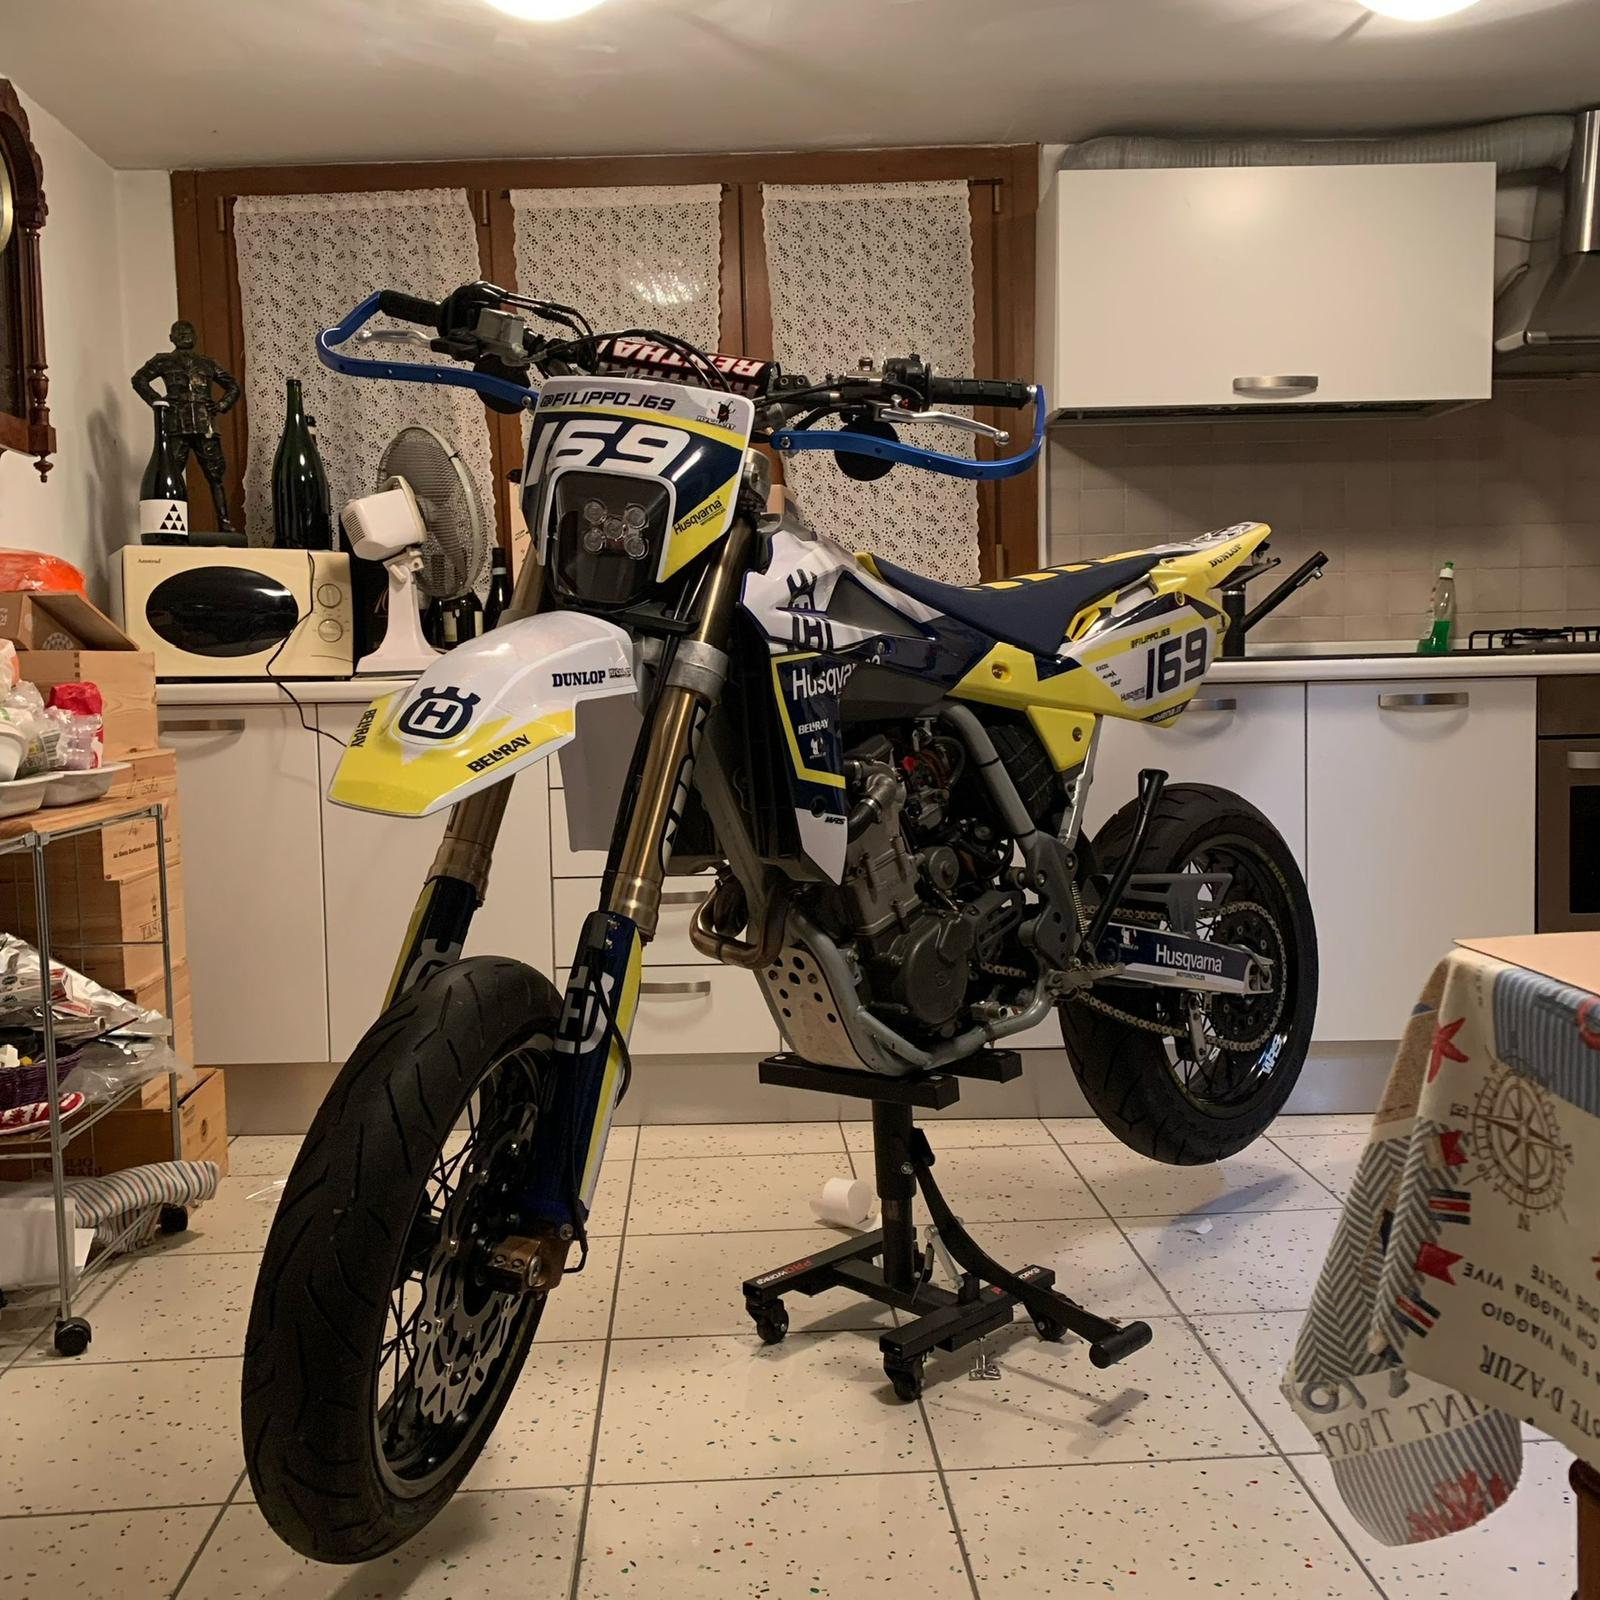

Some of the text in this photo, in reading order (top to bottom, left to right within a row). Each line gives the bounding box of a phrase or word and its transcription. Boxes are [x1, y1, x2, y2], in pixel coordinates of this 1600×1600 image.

[539, 391, 676, 411] @FILIPPO_J69
[526, 419, 690, 486] 169
[673, 499, 722, 535] Husqvarna
[1208, 544, 1242, 568] DUNLOP
[552, 669, 606, 687] DUNLOP
[792, 655, 880, 700] Husqva
[1145, 627, 1207, 700] 169
[1155, 943, 1222, 973] Husqvarna
[1462, 1262, 1597, 1350] CHI VIAGGIA VIVE
[1530, 1264, 1600, 1325] DUE VOLTE
[1481, 1302, 1554, 1350] VIAGGIO
